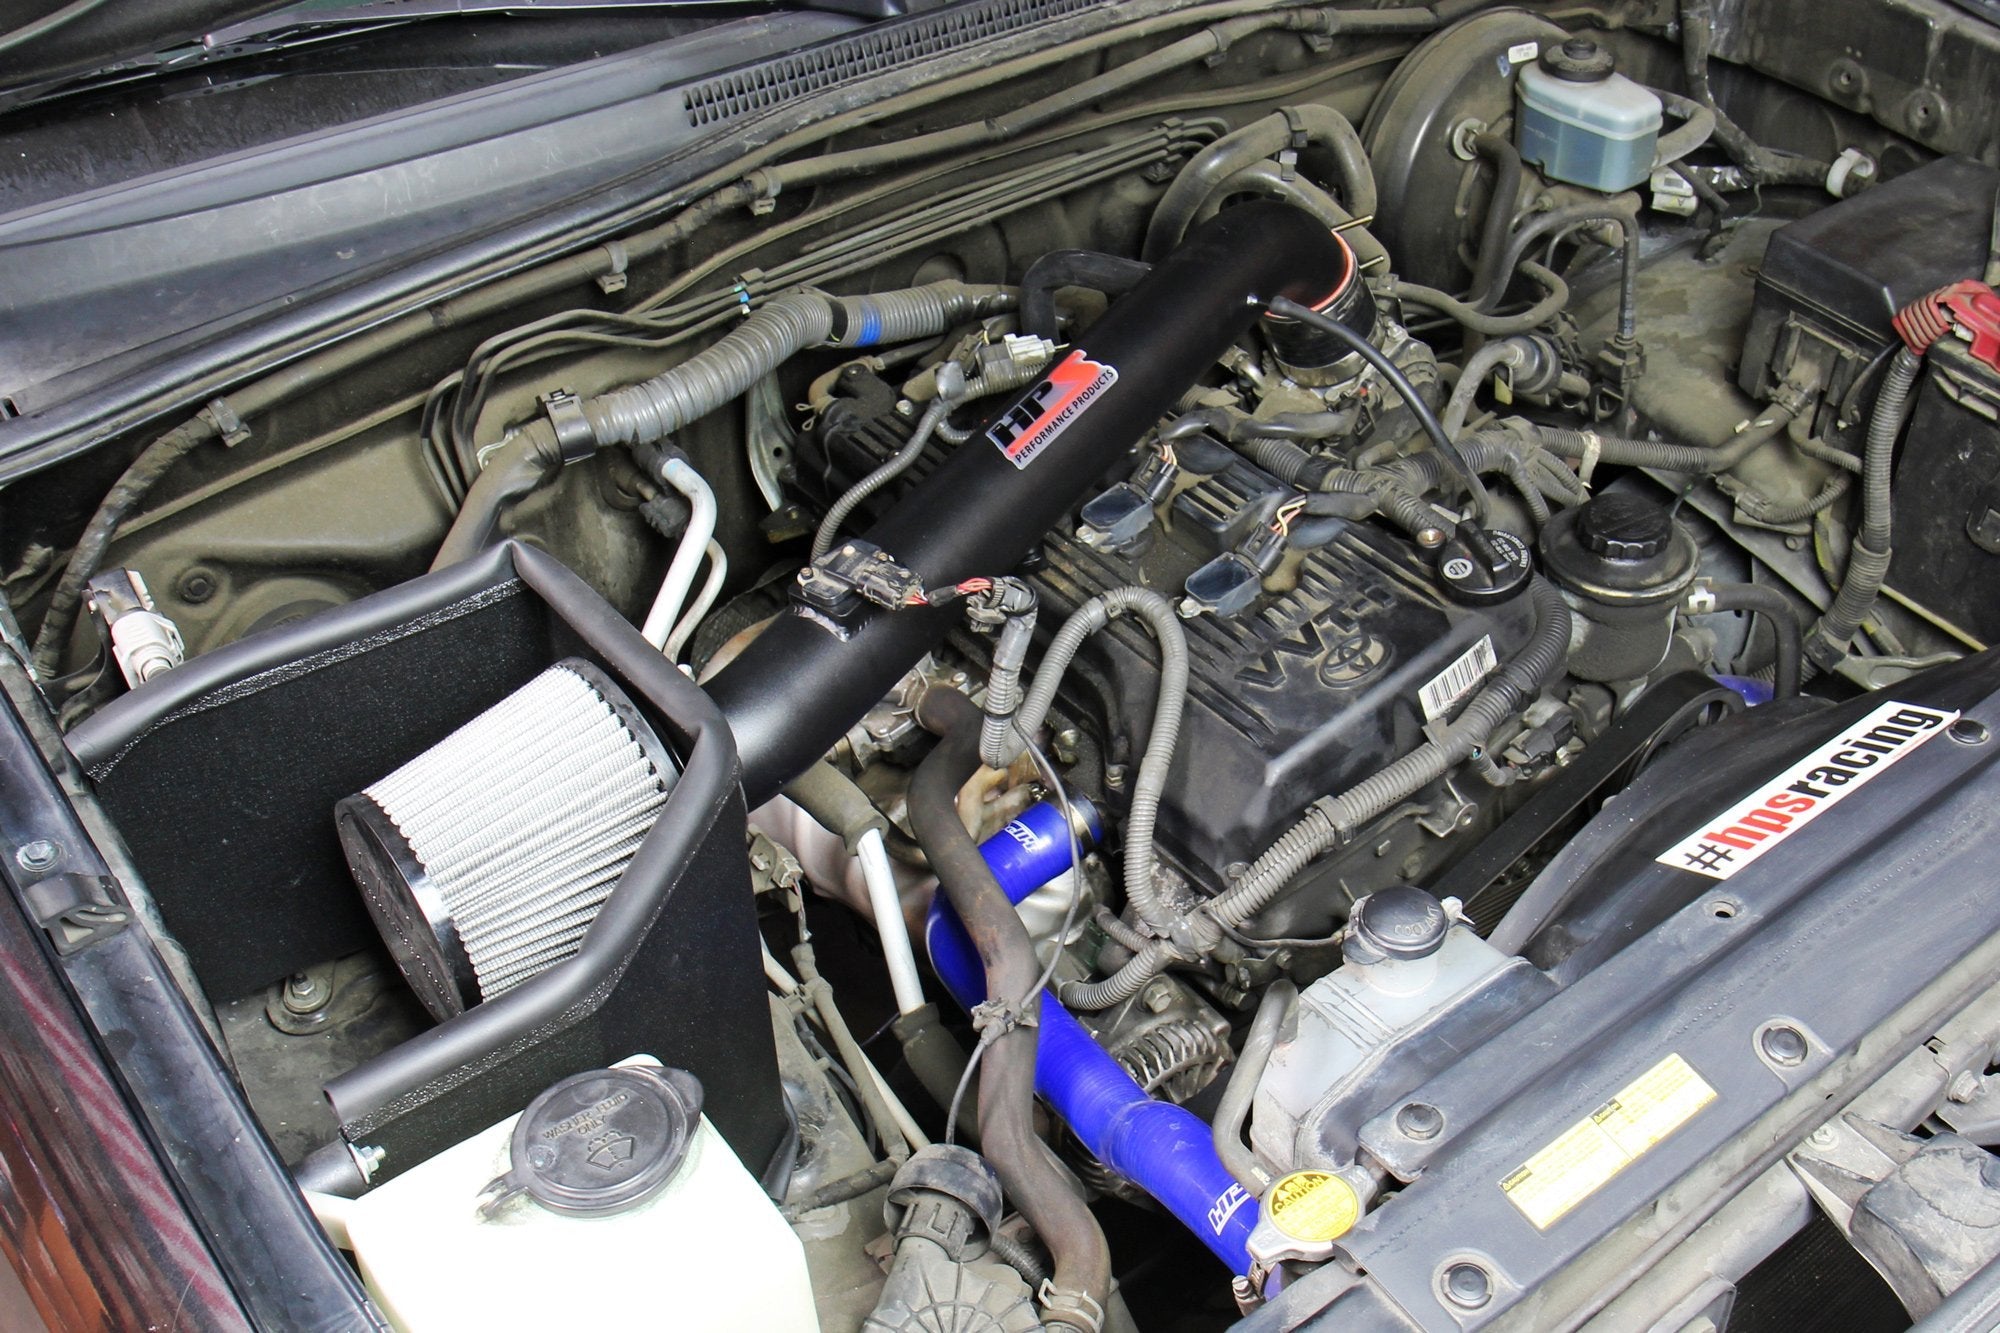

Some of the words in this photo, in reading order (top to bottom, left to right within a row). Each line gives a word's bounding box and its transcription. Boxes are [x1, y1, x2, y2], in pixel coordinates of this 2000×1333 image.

[991, 350, 1100, 455] HPS
[1014, 407, 1074, 463] PERFORMANCE
[1073, 369, 1114, 410] PRODUCTS
[1683, 708, 1944, 872] #hpsracing
[542, 1111, 593, 1139] WASHER
[577, 1115, 606, 1135] ONLY
[1274, 1175, 1324, 1212] CAUTION
